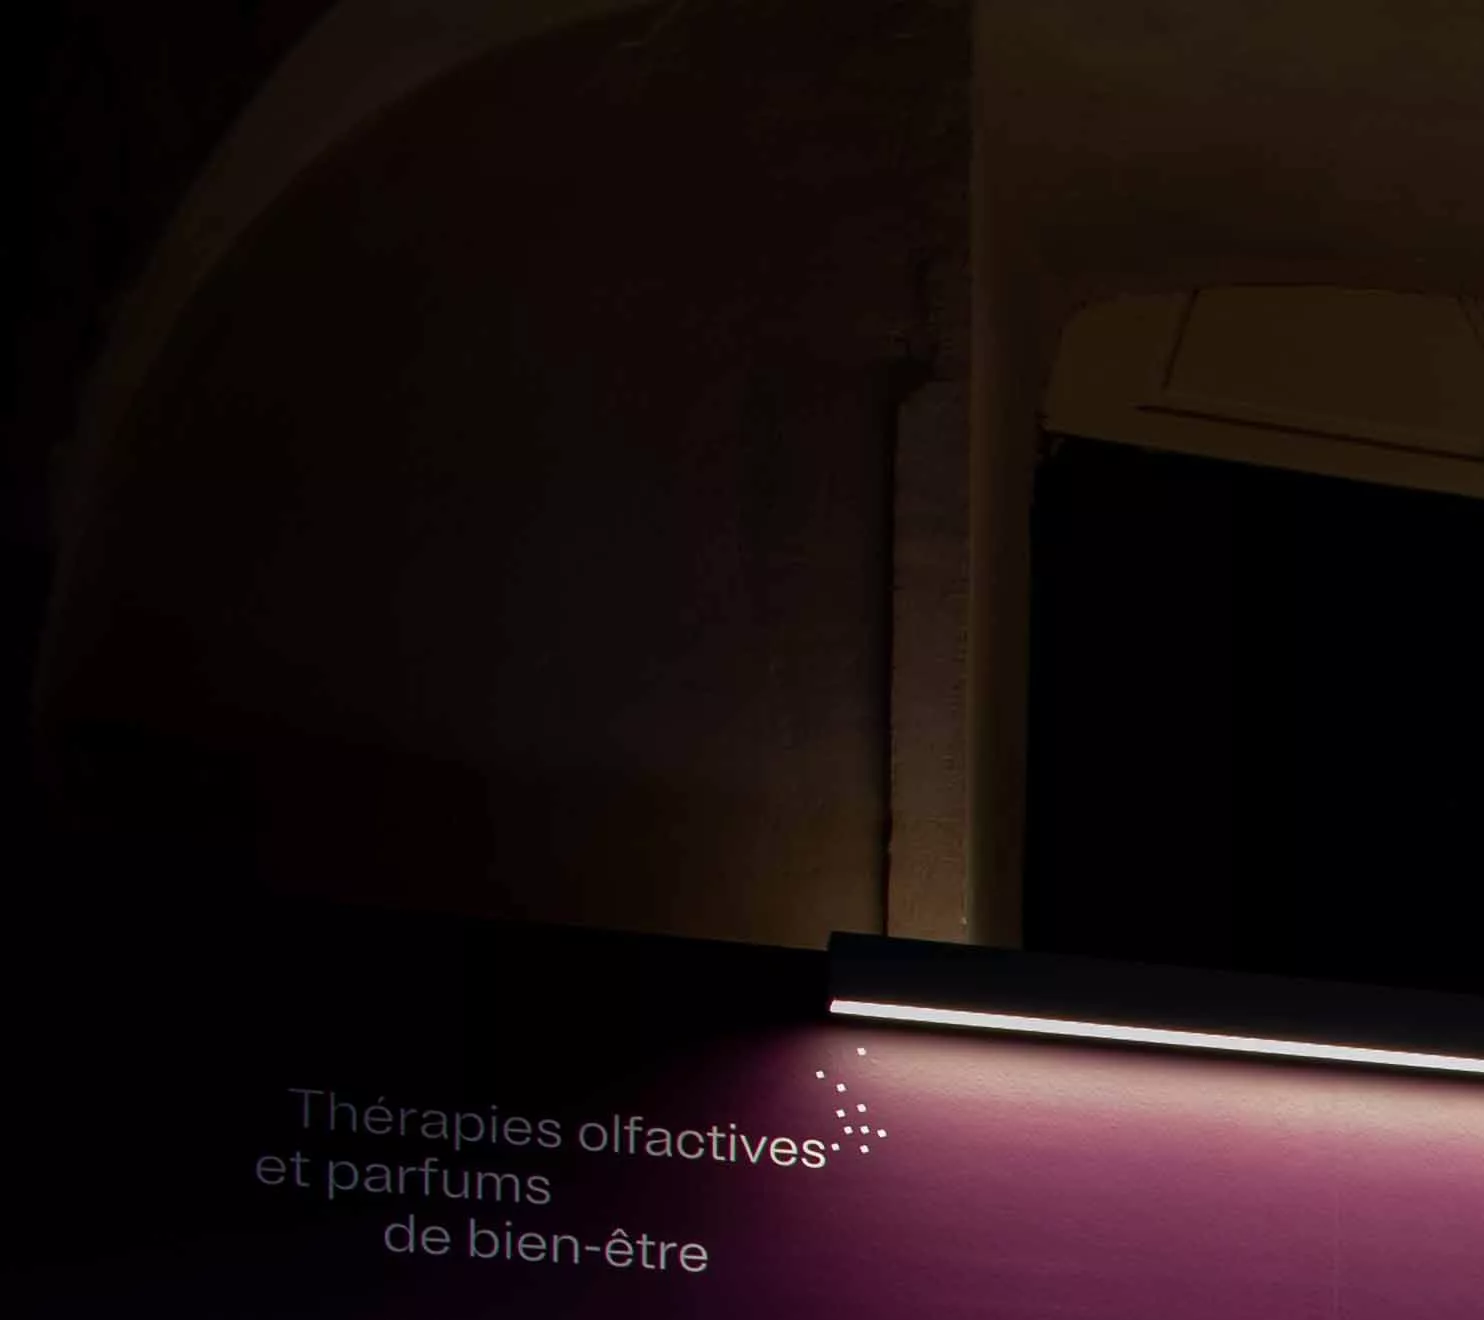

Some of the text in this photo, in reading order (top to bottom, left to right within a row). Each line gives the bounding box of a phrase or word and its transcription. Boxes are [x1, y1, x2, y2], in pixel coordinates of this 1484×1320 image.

[288, 1088, 826, 1168] Thérapies olfactives
[256, 1151, 550, 1204] et parfums
[384, 1214, 708, 1272] de bien-être
